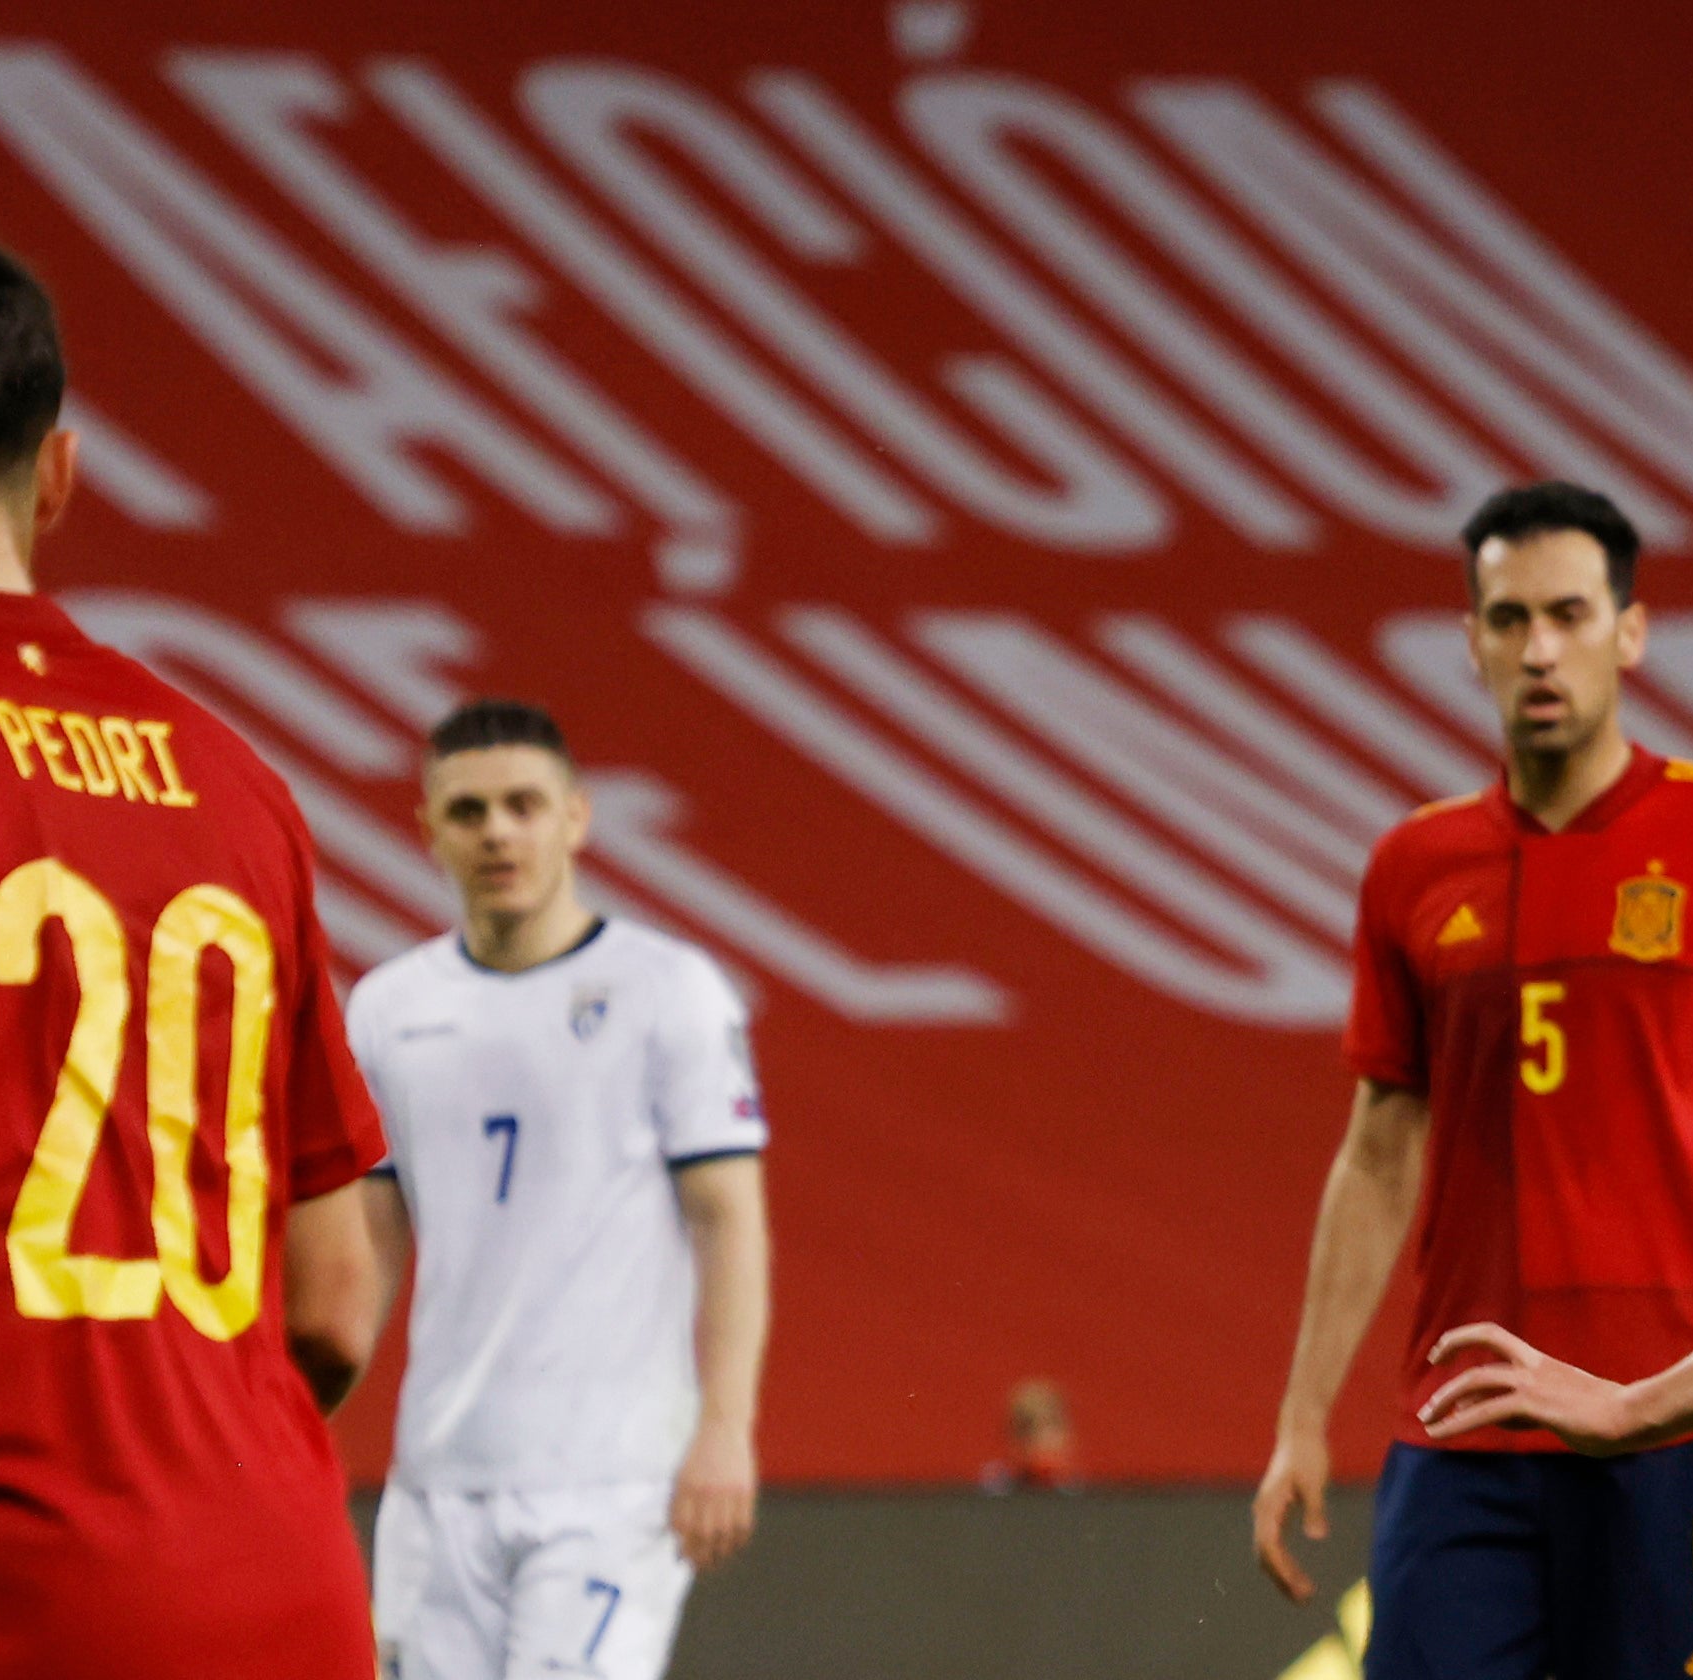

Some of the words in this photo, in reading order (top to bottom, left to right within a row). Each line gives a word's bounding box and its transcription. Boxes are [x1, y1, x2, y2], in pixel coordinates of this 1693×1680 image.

[1519, 981, 1568, 1095] 5
[483, 1115, 519, 1203] 7
[583, 1577, 622, 1662] 7
